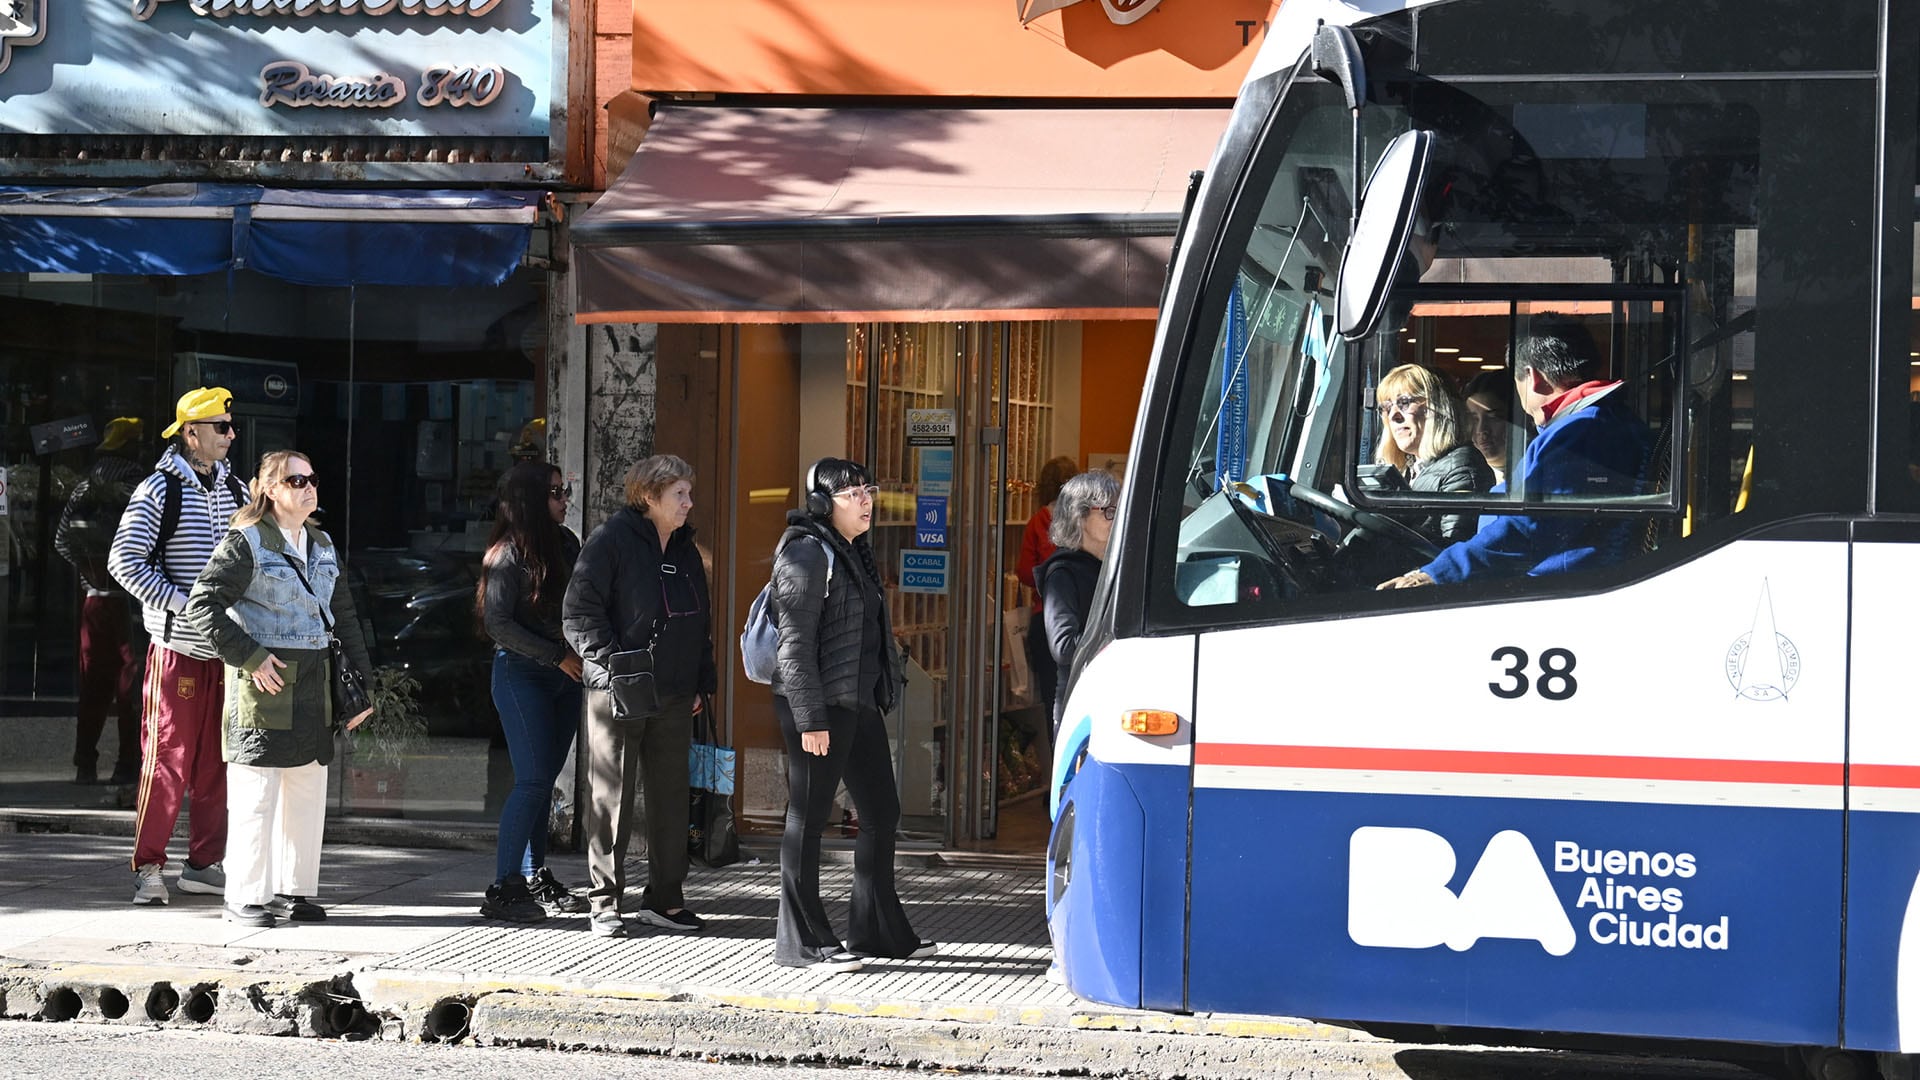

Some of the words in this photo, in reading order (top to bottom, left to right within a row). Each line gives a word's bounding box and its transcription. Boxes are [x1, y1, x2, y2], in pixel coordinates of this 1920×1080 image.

[263, 65, 398, 101] Rosario
[421, 67, 497, 101] 840
[63, 423, 88, 433] Abierto
[911, 424, 951, 433] 4582-9341
[919, 533, 944, 544] VISA
[916, 576, 942, 584] CABAL
[917, 558, 942, 566] CABAL
[1488, 646, 1578, 701] 38
[1728, 638, 1748, 679] NUEVOS
[1780, 640, 1798, 682] RUMBOS
[1554, 840, 1697, 879] Buenos
[1347, 825, 1577, 957] BA
[1576, 878, 1684, 914] Aires
[1588, 912, 1729, 951] Ciudad
